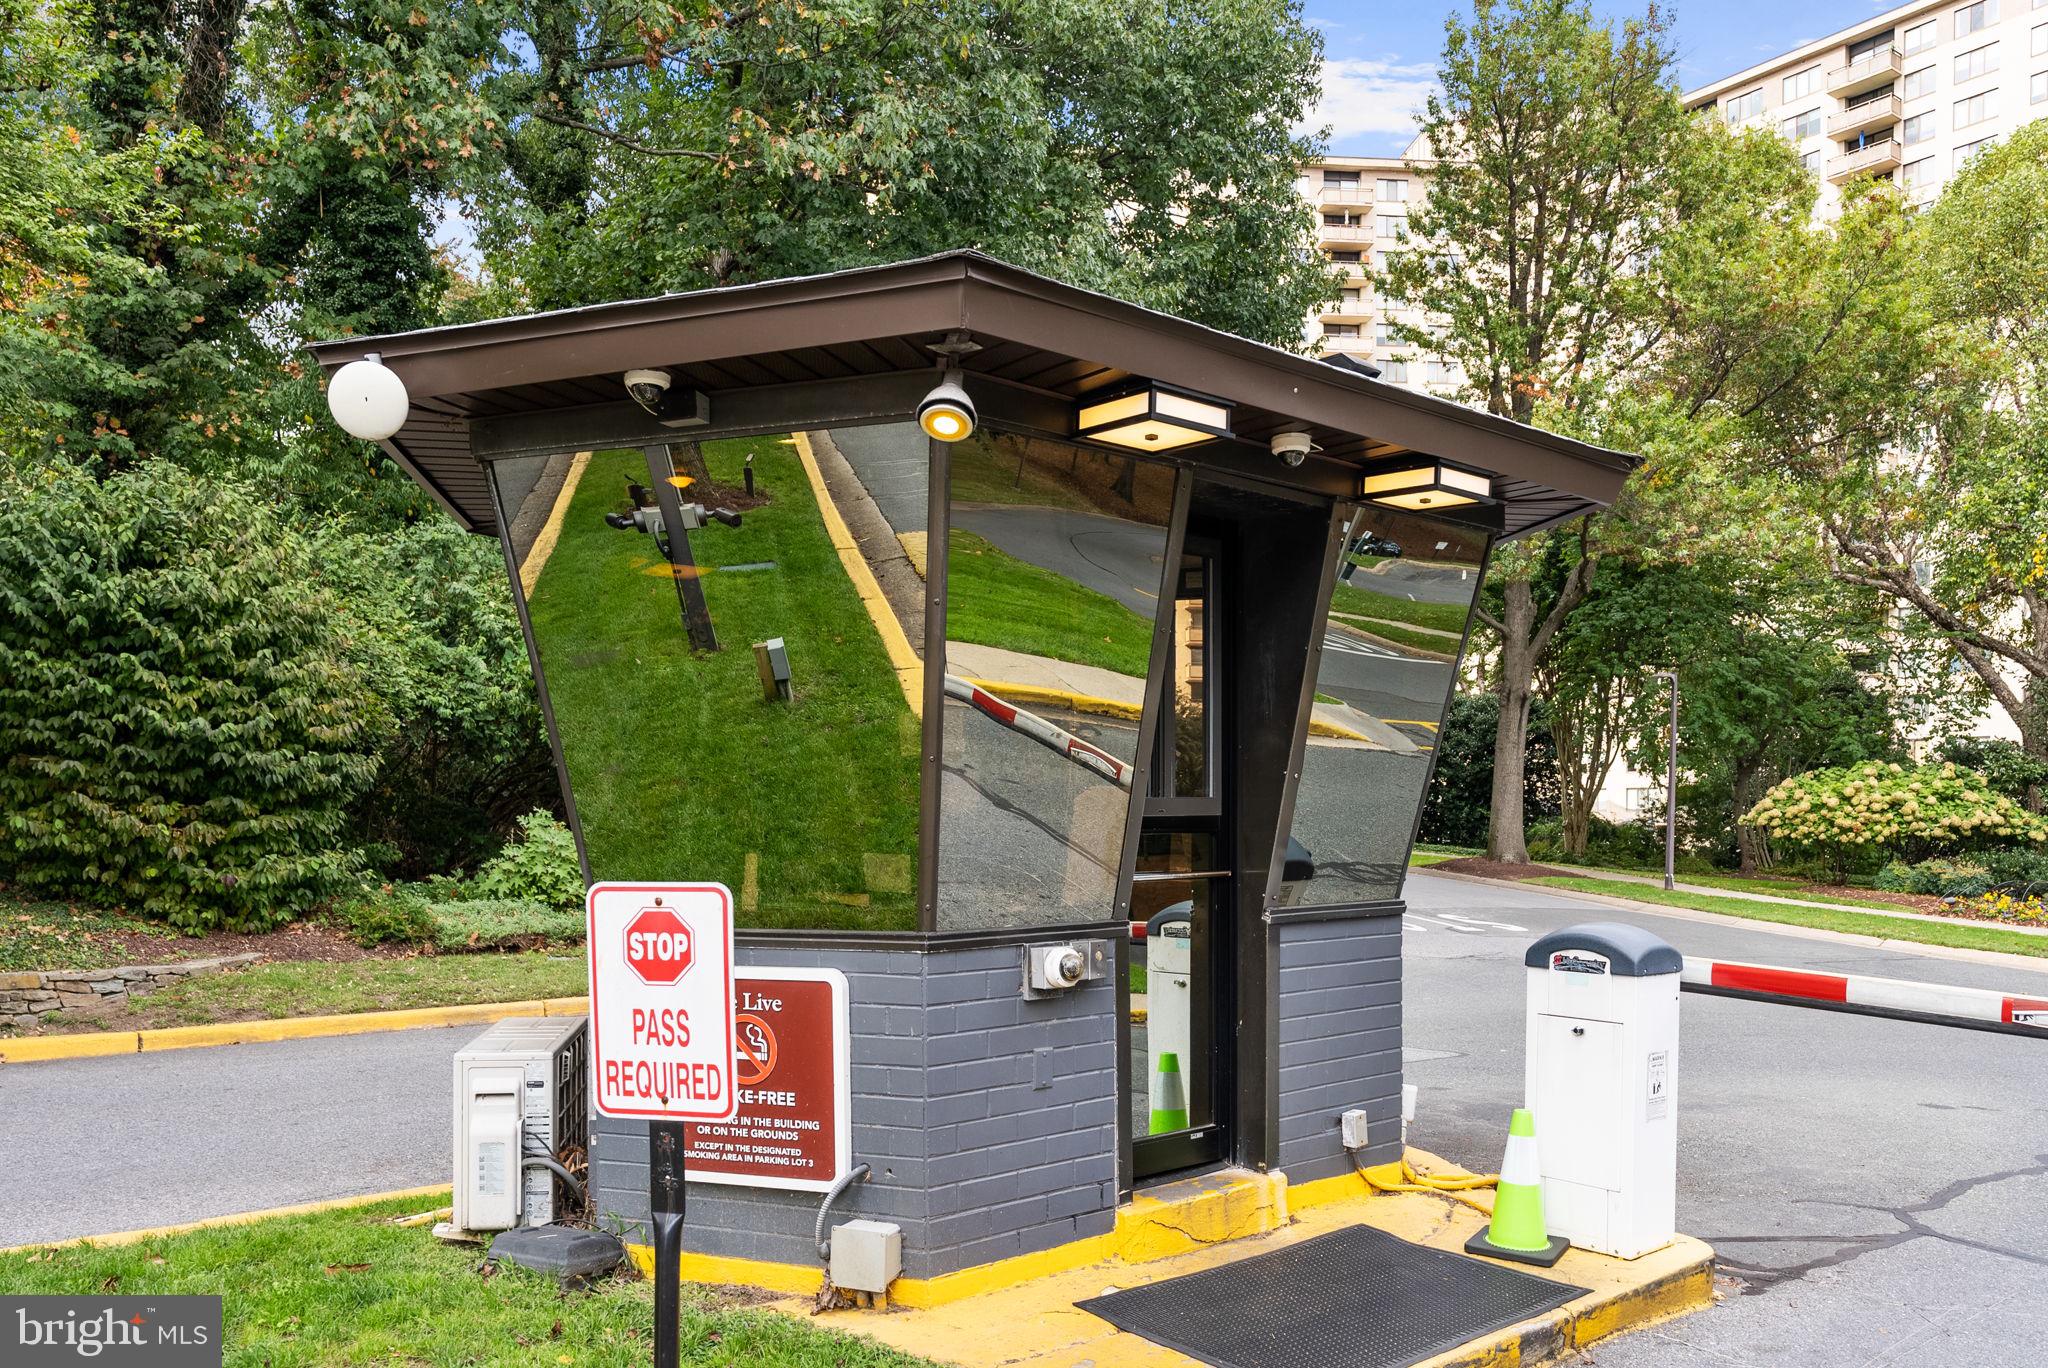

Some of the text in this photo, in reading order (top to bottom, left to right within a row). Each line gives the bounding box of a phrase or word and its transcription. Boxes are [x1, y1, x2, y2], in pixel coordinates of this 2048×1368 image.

[629, 931, 689, 961] STOP
[742, 992, 783, 1011] Live
[632, 1008, 691, 1048] PASS
[606, 1059, 722, 1101] REQUIRED
[737, 1089, 796, 1107] KE-FREE
[740, 1116, 752, 1126] IN
[753, 1117, 772, 1127] THE
[774, 1118, 820, 1131] BUILDING
[697, 1125, 799, 1141] OR ON THE GROUNDS
[694, 1141, 802, 1157] EXCEPT IN THE DESIGNATED
[684, 1150, 814, 1167] SMOKING AREA IN PARKING LOT 3
